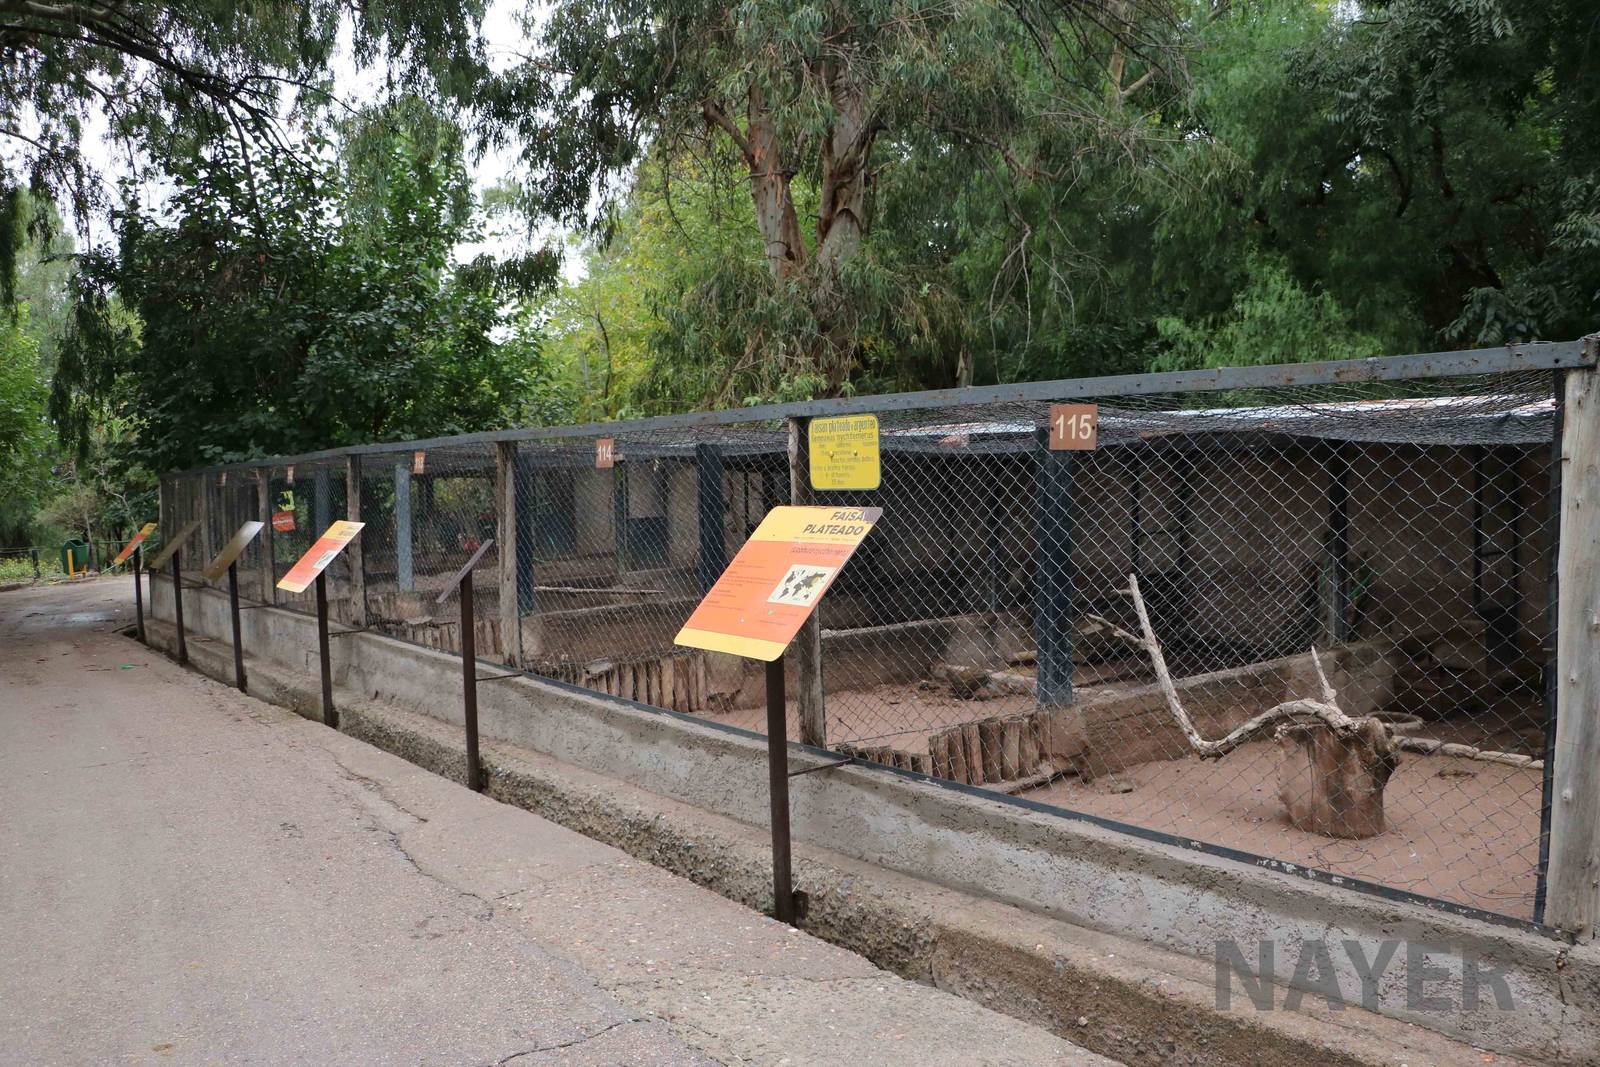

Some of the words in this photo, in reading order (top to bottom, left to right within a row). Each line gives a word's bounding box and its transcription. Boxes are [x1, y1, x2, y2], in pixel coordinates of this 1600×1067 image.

[1055, 413, 1092, 440] 115
[598, 444, 612, 462] 114
[830, 511, 864, 521] FAISA
[802, 524, 864, 536] PLATEADO
